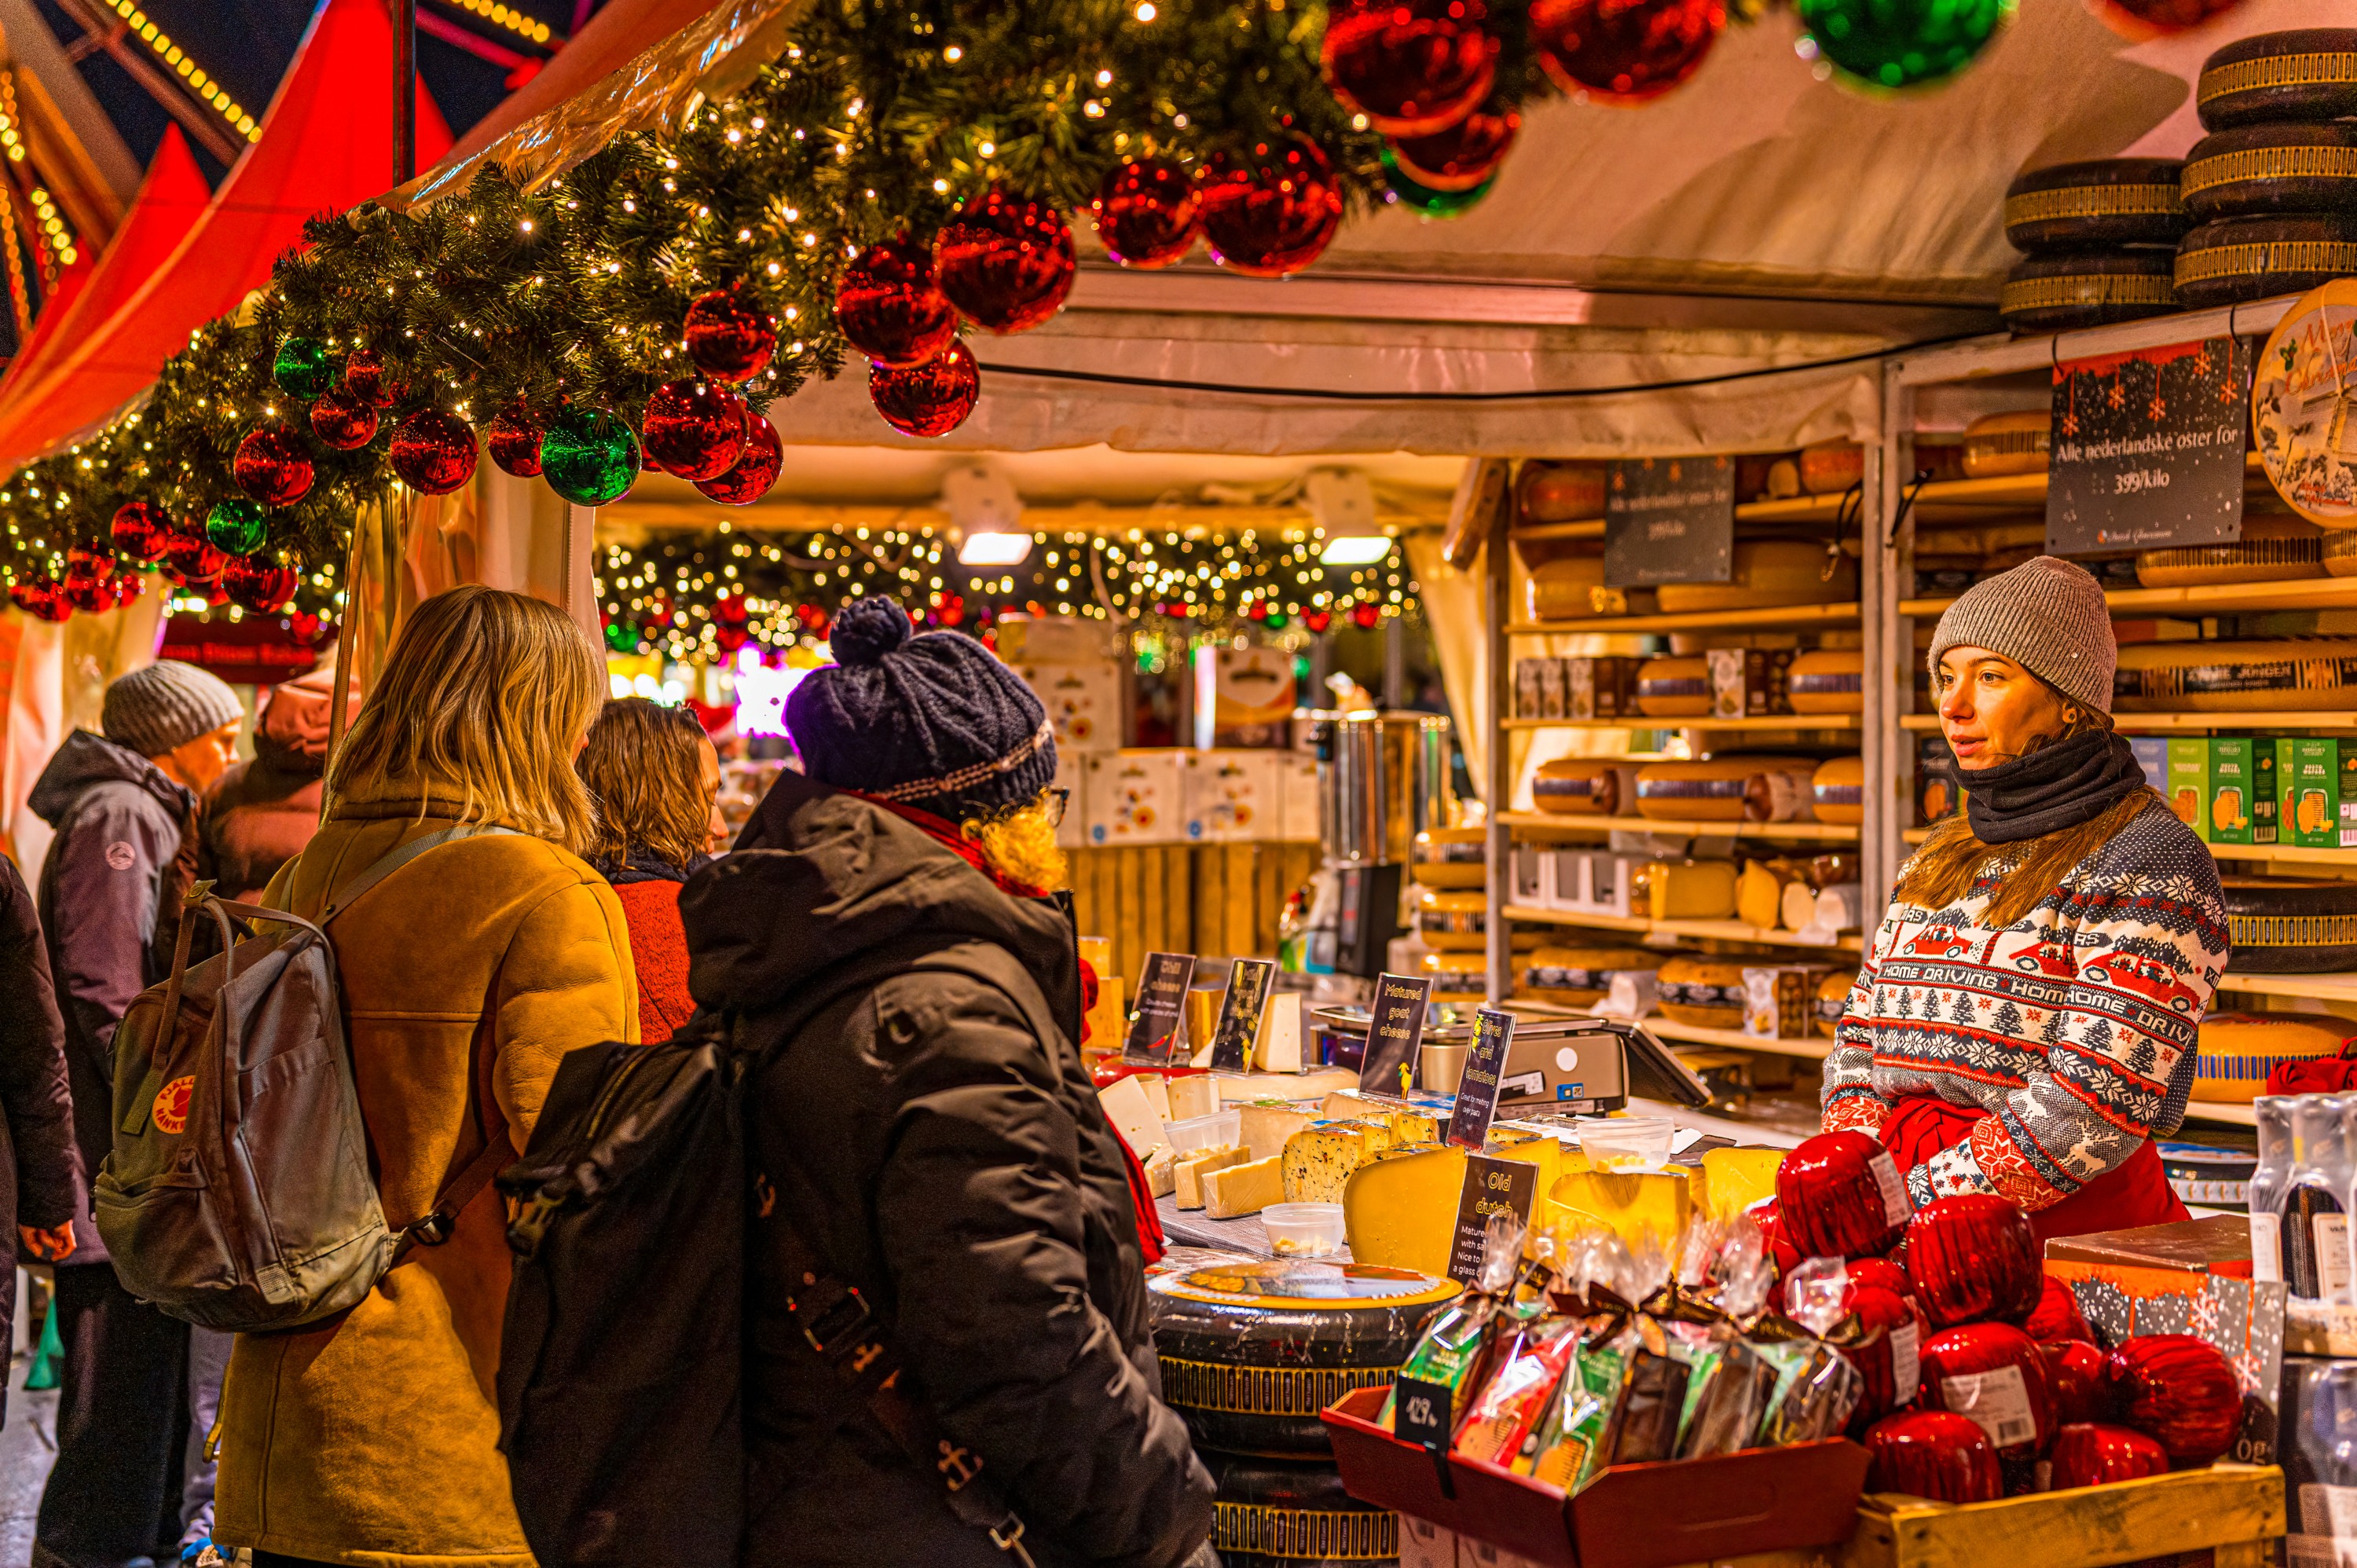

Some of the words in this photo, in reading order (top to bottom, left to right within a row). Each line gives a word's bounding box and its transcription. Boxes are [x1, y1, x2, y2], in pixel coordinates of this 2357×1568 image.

[2056, 442, 2083, 463] Alle
[2084, 431, 2173, 460] nederlandske
[2176, 433, 2212, 451] oster
[2216, 424, 2238, 445] for
[2113, 467, 2170, 495] 399/kilo
[1384, 983, 1424, 1001] Matured
[1884, 965, 1919, 979] HOME
[1923, 967, 1998, 990] DRIVING
[2011, 980, 2066, 1003] HOM
[2065, 990, 2127, 1014] HOME
[1388, 1007, 1410, 1020] goat
[1380, 1024, 1411, 1039] cheese
[1482, 1019, 1502, 1038] Olives
[1479, 1046, 1494, 1060] and
[1465, 1065, 1497, 1086] tomatoes
[1487, 1172, 1512, 1192] Old
[1475, 1197, 1513, 1218] dutch
[1461, 1240, 1476, 1249] with
[1457, 1251, 1472, 1262] Nice
[1458, 1266, 1475, 1276] glass
